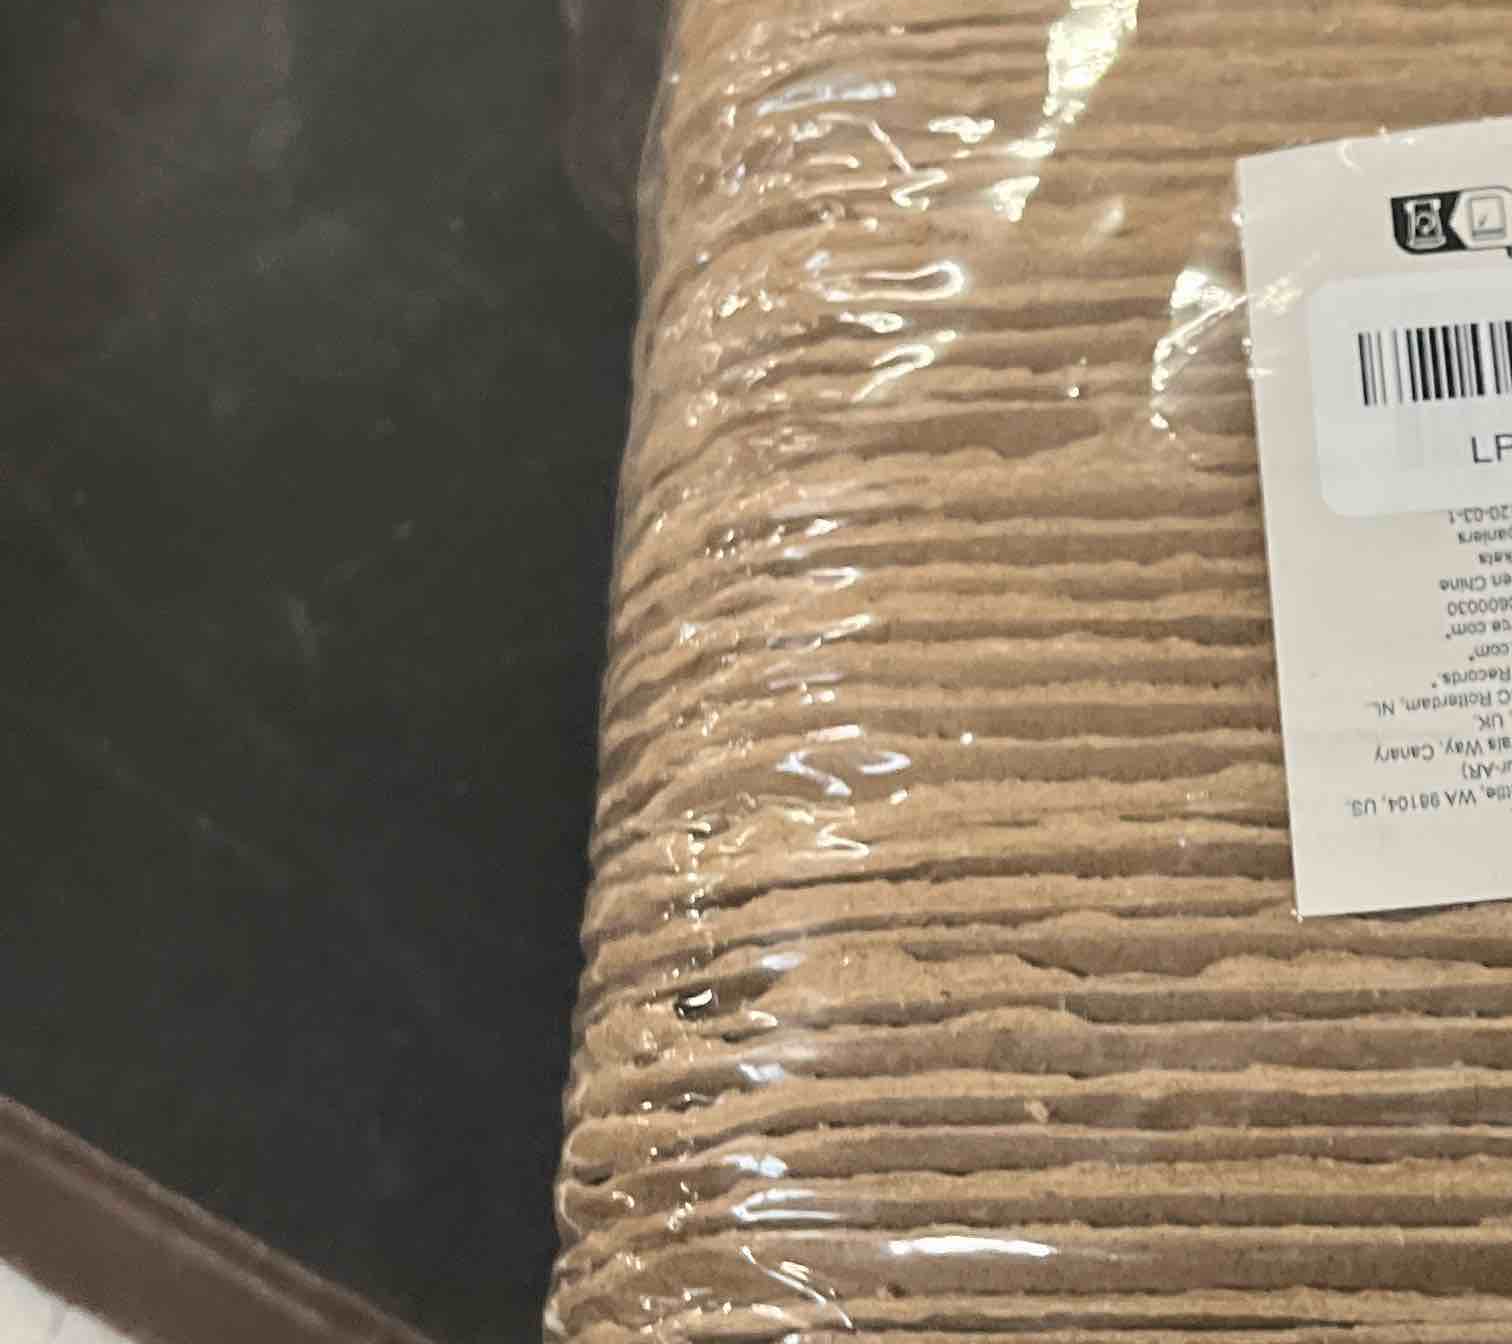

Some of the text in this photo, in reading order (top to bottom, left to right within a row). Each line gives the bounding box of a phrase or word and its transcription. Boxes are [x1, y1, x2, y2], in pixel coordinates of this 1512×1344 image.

[1437, 574, 1488, 593] Chine
[1489, 570, 1512, 589] en
[1399, 689, 1494, 713] Rotterdam,
[1374, 742, 1436, 764] Canary
[1439, 736, 1485, 759] Way,
[1380, 791, 1441, 814] 98104,
[1443, 787, 1478, 808] WA
